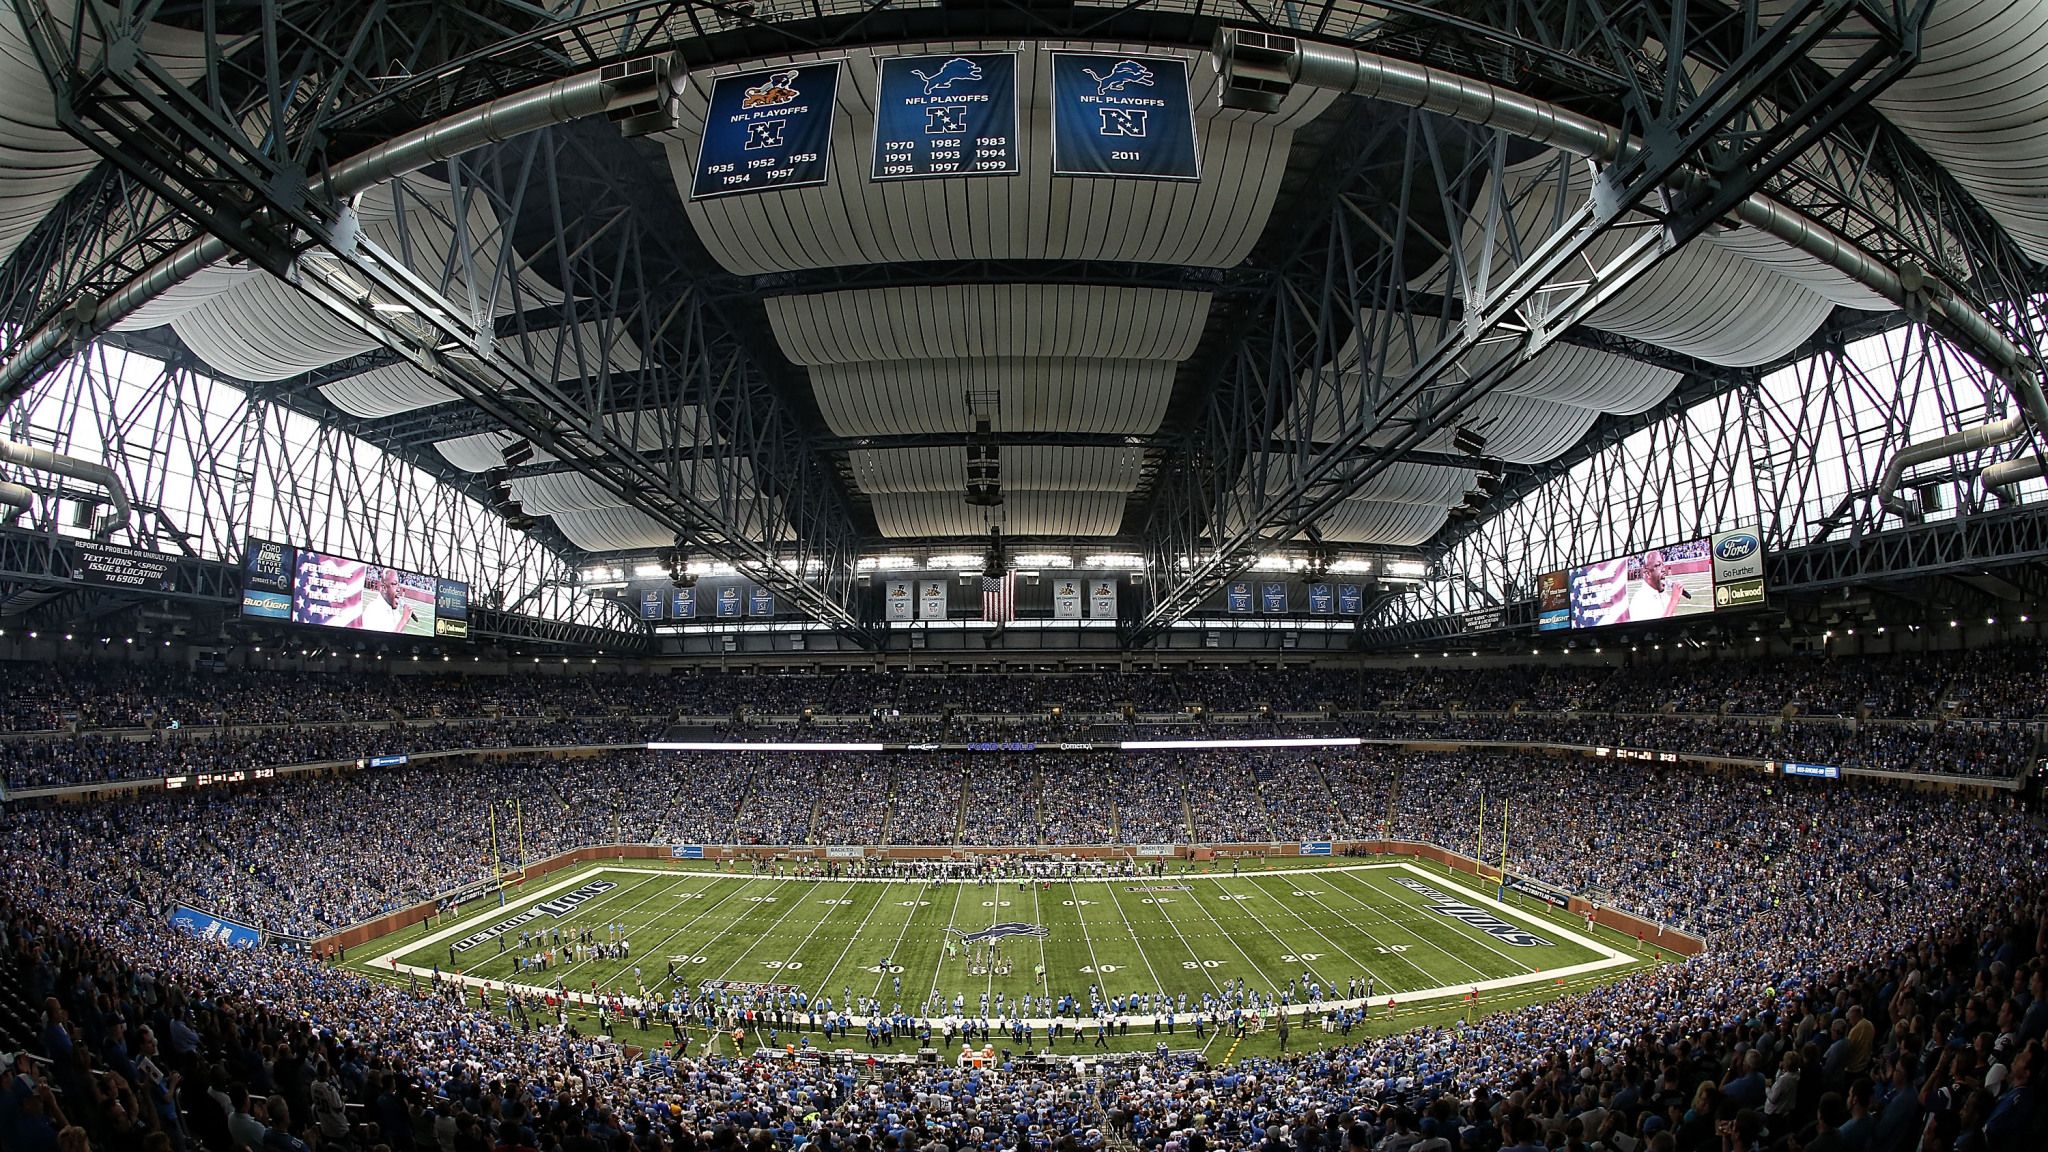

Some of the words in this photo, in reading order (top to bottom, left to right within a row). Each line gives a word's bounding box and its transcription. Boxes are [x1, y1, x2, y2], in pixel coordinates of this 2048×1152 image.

[930, 95, 989, 103] PLAYOFFS
[1106, 96, 1165, 106] PLAYOFFS
[731, 114, 750, 122] NFL
[753, 106, 808, 119] PLAYOFFS
[886, 141, 914, 150] 1970
[931, 139, 960, 148] 1982
[976, 137, 1006, 146] 1983
[885, 153, 912, 162] 1991
[930, 151, 960, 160] 1993
[976, 149, 1006, 158] 1994
[1112, 151, 1140, 160] 2011
[708, 164, 734, 174] 1935
[748, 158, 775, 169] 1952
[789, 154, 817, 164] 1953
[884, 165, 913, 174] 1995
[930, 163, 960, 172] 1997
[976, 161, 1006, 170] 1999
[723, 174, 750, 185] 1954
[767, 168, 794, 179] 1957
[75, 541, 98, 550] REPORT
[105, 546, 132, 556] PROBLEM
[143, 552, 165, 561] UNRULY
[262, 543, 280, 553] FORD
[1723, 538, 1750, 557] Ford
[257, 550, 282, 561] LIONS
[83, 553, 103, 562] TEXT
[105, 557, 136, 567] "LIONS"
[138, 562, 167, 572] <SPACE>
[88, 563, 113, 572] ISSUE
[122, 567, 163, 579] LOCATION
[257, 565, 280, 575] LIVE
[1733, 567, 1754, 576] Further
[117, 575, 145, 584] 69050
[1732, 586, 1761, 598] Oakwood
[243, 598, 262, 607] BUD
[266, 602, 289, 610] LIGHT
[447, 625, 466, 633] Oakwood
[968, 742, 998, 750] FORD
[256, 769, 273, 778] 3:21
[454, 910, 536, 952] DETROIT
[534, 880, 618, 919] LIONS
[1423, 903, 1555, 947] LIONS
[1373, 945, 1407, 954] 10
[671, 955, 707, 964] 20
[1281, 953, 1317, 962] 20
[766, 961, 803, 970] 30
[1079, 965, 1116, 974] 40
[1182, 960, 1219, 969] 30
